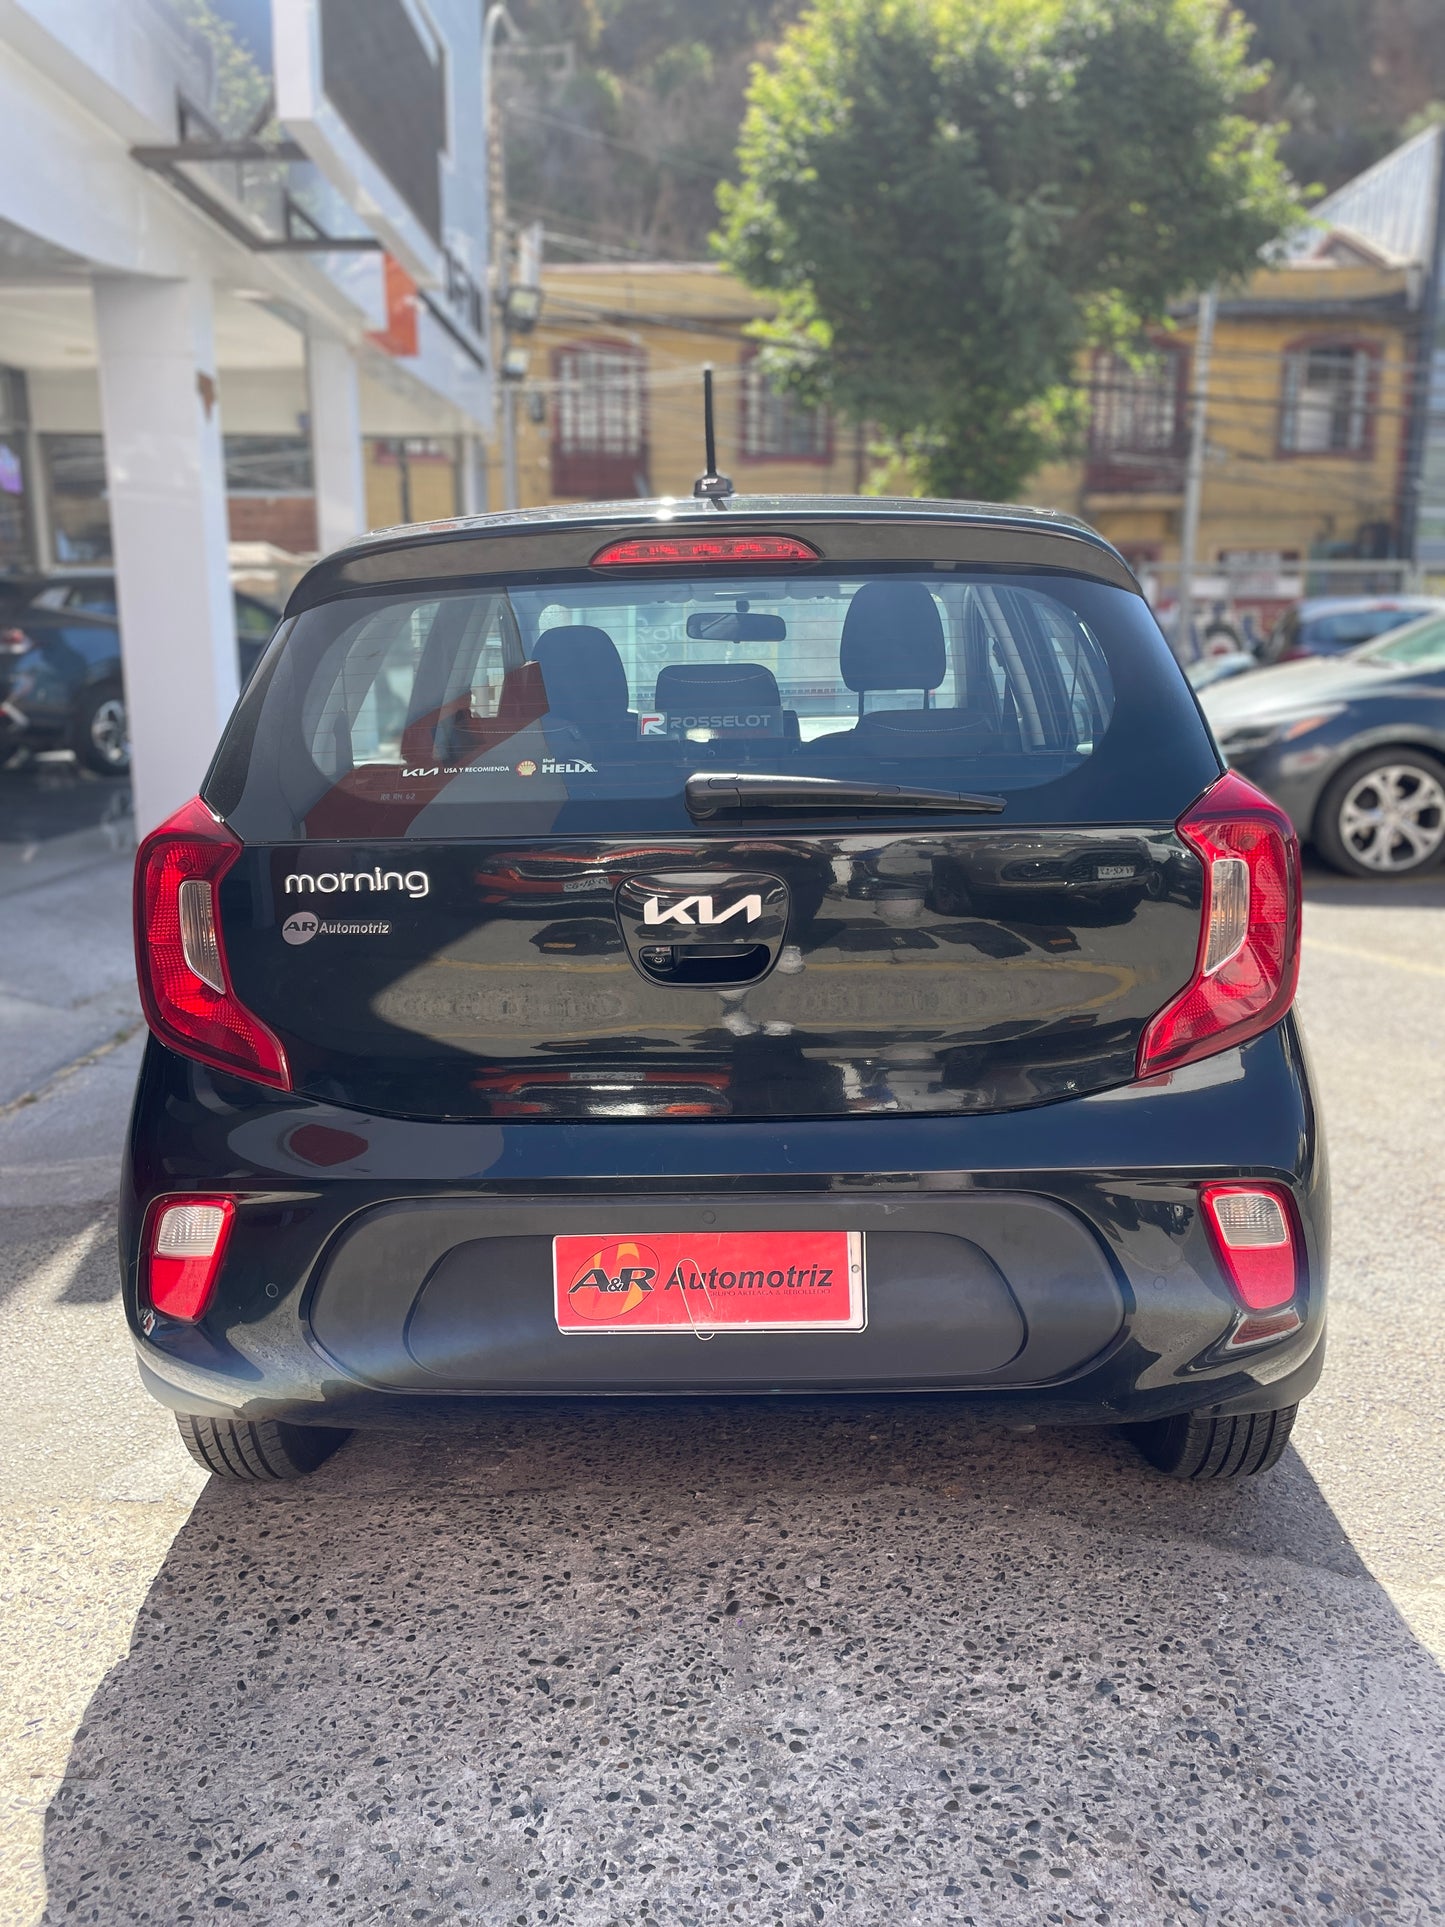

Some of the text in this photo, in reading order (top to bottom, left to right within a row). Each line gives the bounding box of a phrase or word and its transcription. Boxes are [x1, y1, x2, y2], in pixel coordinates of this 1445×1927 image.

[670, 714, 771, 729] ROSSELOT
[402, 767, 439, 777] KIA
[541, 760, 598, 774] HELIX
[285, 866, 430, 898] morning
[643, 894, 762, 925] KIA
[319, 921, 390, 934] Automotriz
[568, 1263, 834, 1293] A&R Automotriz
